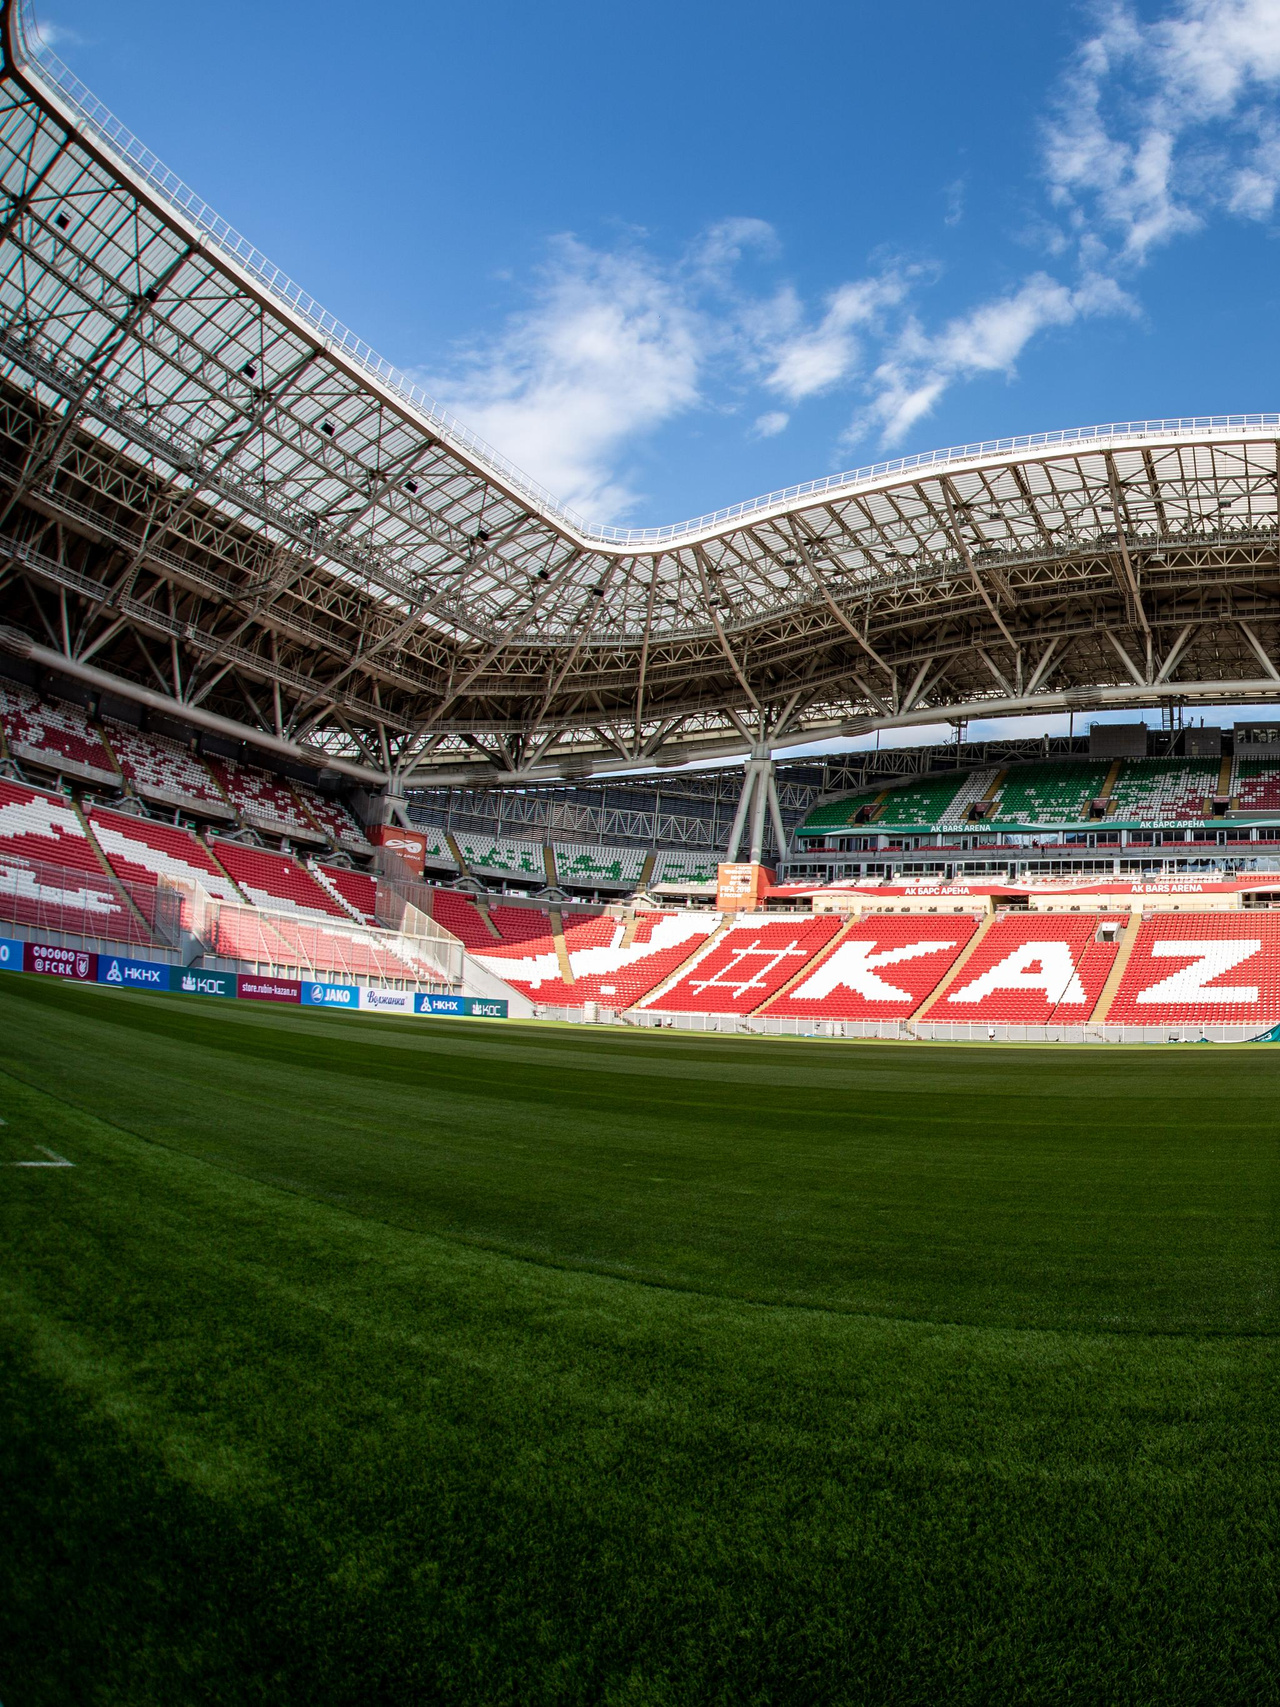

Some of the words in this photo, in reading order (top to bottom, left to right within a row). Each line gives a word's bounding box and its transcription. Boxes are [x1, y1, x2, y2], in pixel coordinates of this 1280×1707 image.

[964, 824, 991, 832] ARENA
[1177, 820, 1205, 828] АРЕНА
[905, 887, 916, 895] АК
[918, 887, 940, 895] БАРС
[941, 886, 970, 895] АРЕНА
[1131, 884, 1144, 893] AK
[1145, 884, 1170, 893] BARS
[1171, 884, 1203, 893] ARENA
[34, 958, 73, 976] @FCRK
[242, 982, 298, 997] store.rubin-kazan.ru
[324, 988, 351, 1003] JAKO
